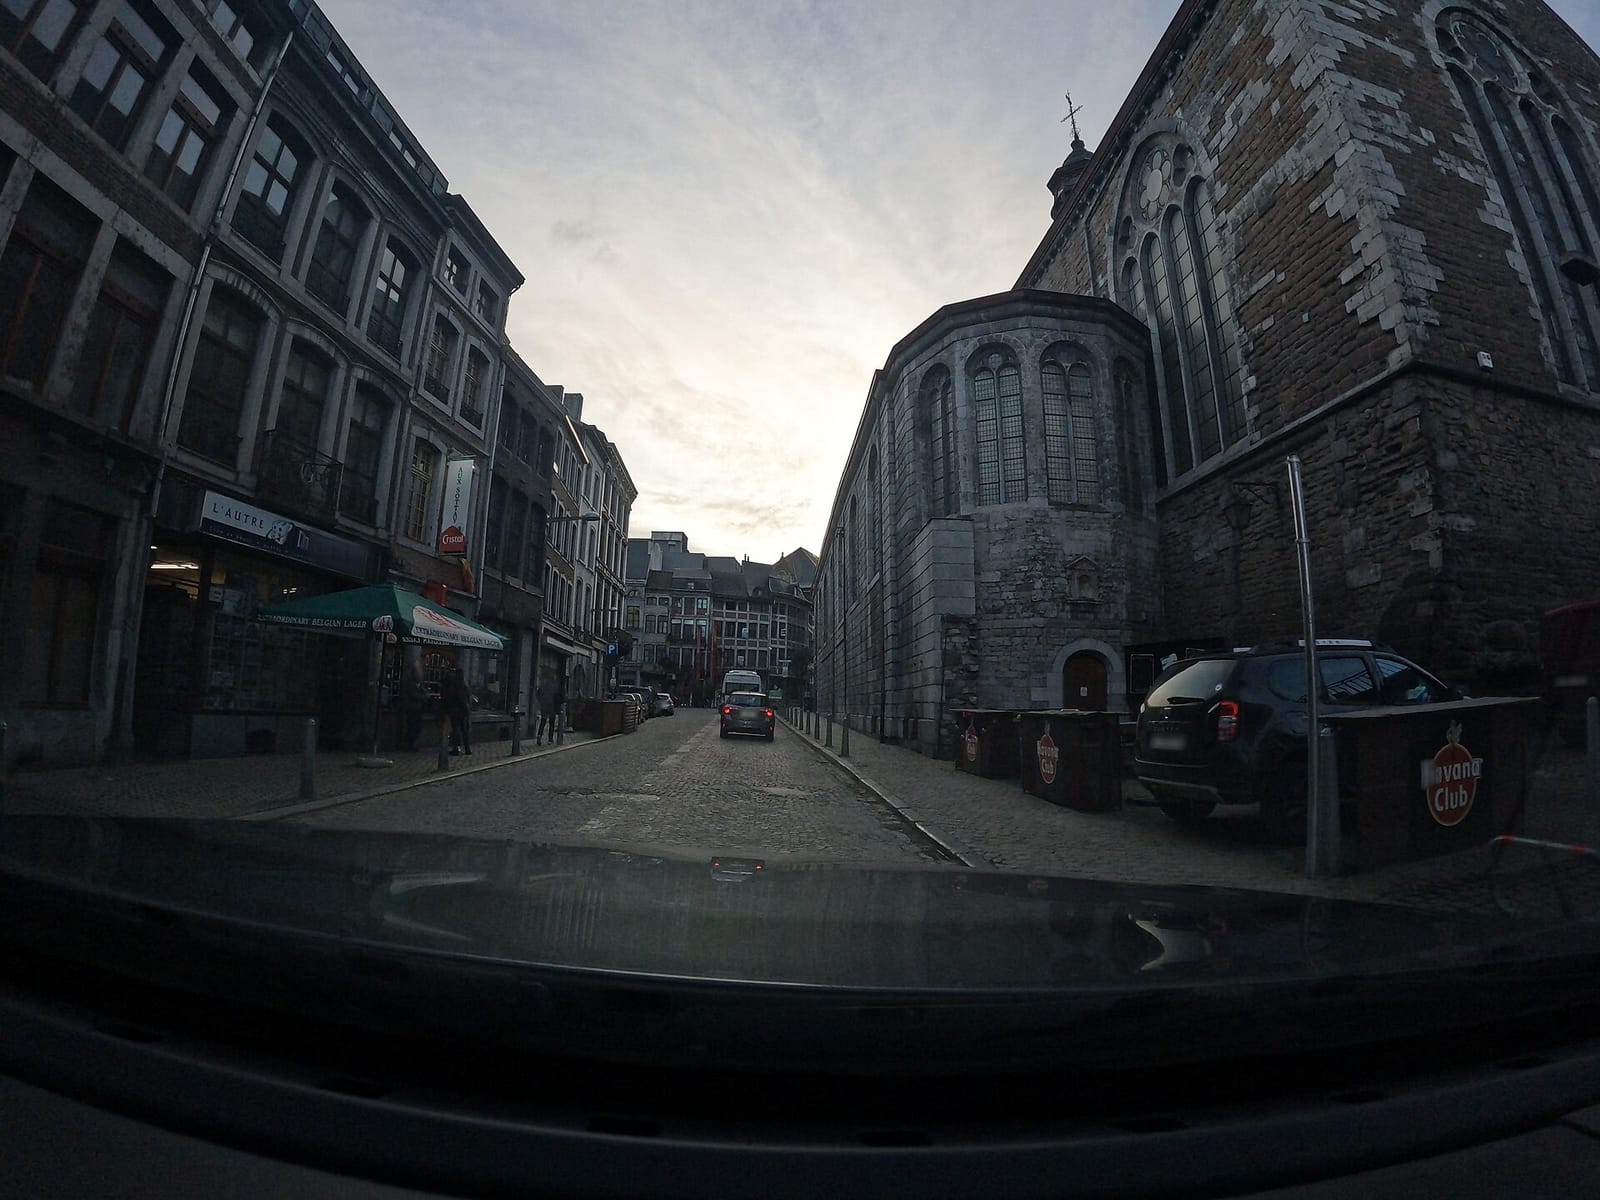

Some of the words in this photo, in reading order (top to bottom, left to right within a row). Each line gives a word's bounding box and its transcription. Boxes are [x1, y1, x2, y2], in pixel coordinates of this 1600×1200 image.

[212, 503, 265, 529] L'AUTRE
[442, 534, 464, 545] Cristal
[312, 618, 341, 628] BELGIAN
[344, 620, 368, 629] LAGER
[608, 644, 617, 655] P
[1435, 784, 1469, 812] Club
